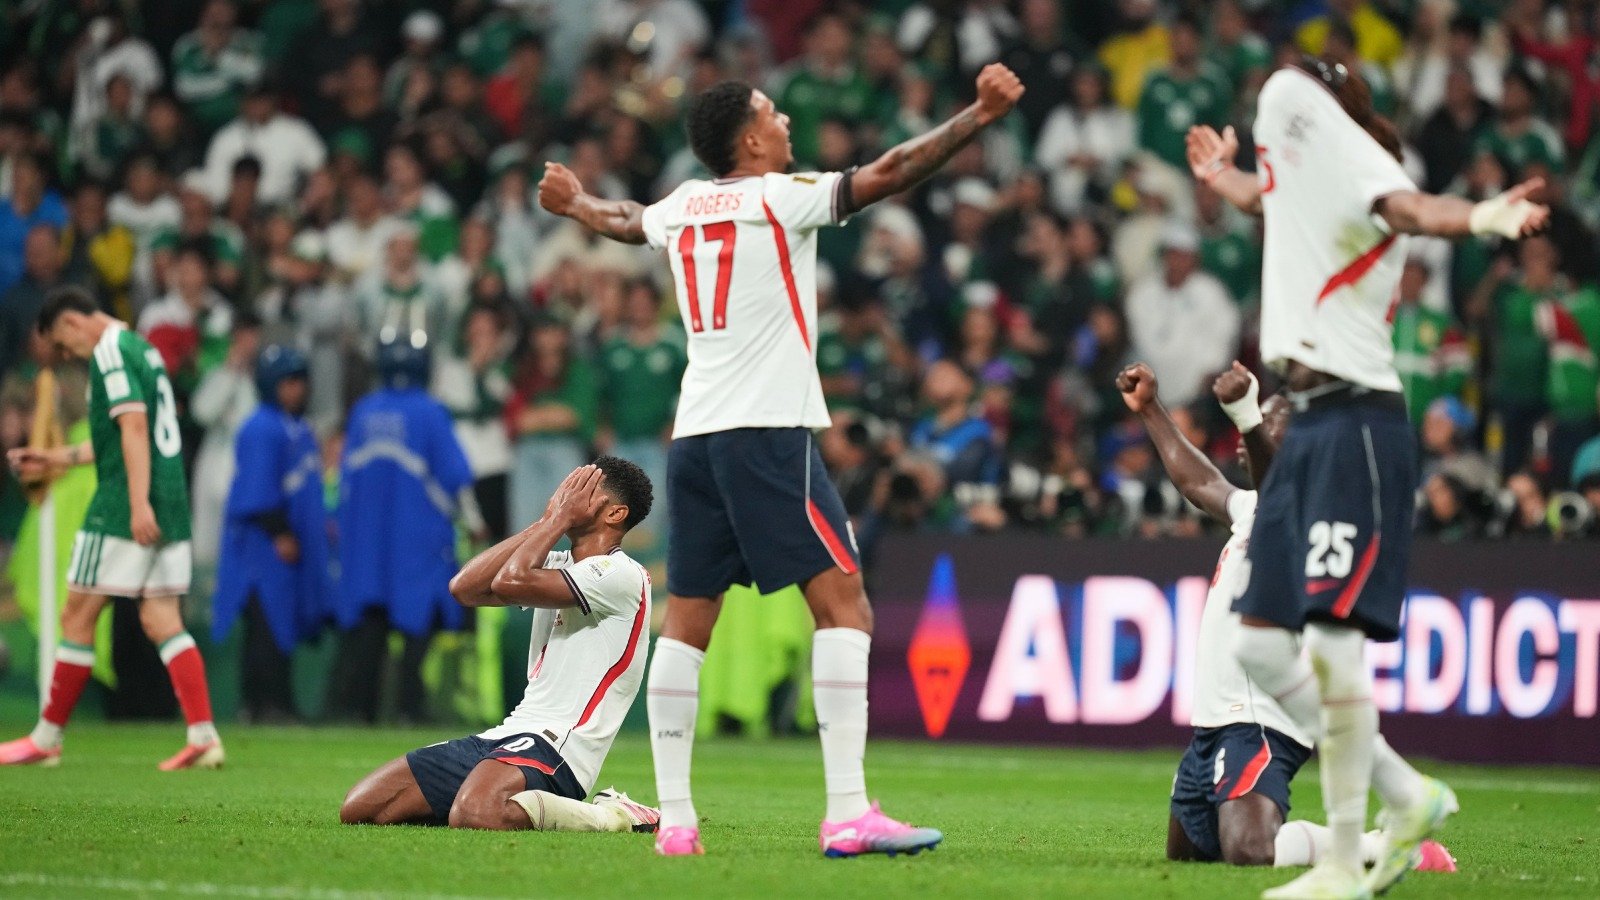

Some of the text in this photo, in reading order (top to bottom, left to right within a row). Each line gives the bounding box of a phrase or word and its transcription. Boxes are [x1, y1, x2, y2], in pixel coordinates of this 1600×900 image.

[1254, 145, 1275, 194] 5
[684, 193, 743, 216] ROGERS
[678, 220, 736, 333] 17
[1304, 520, 1358, 578] 25
[498, 736, 535, 753] 0
[657, 730, 684, 739] ENG
